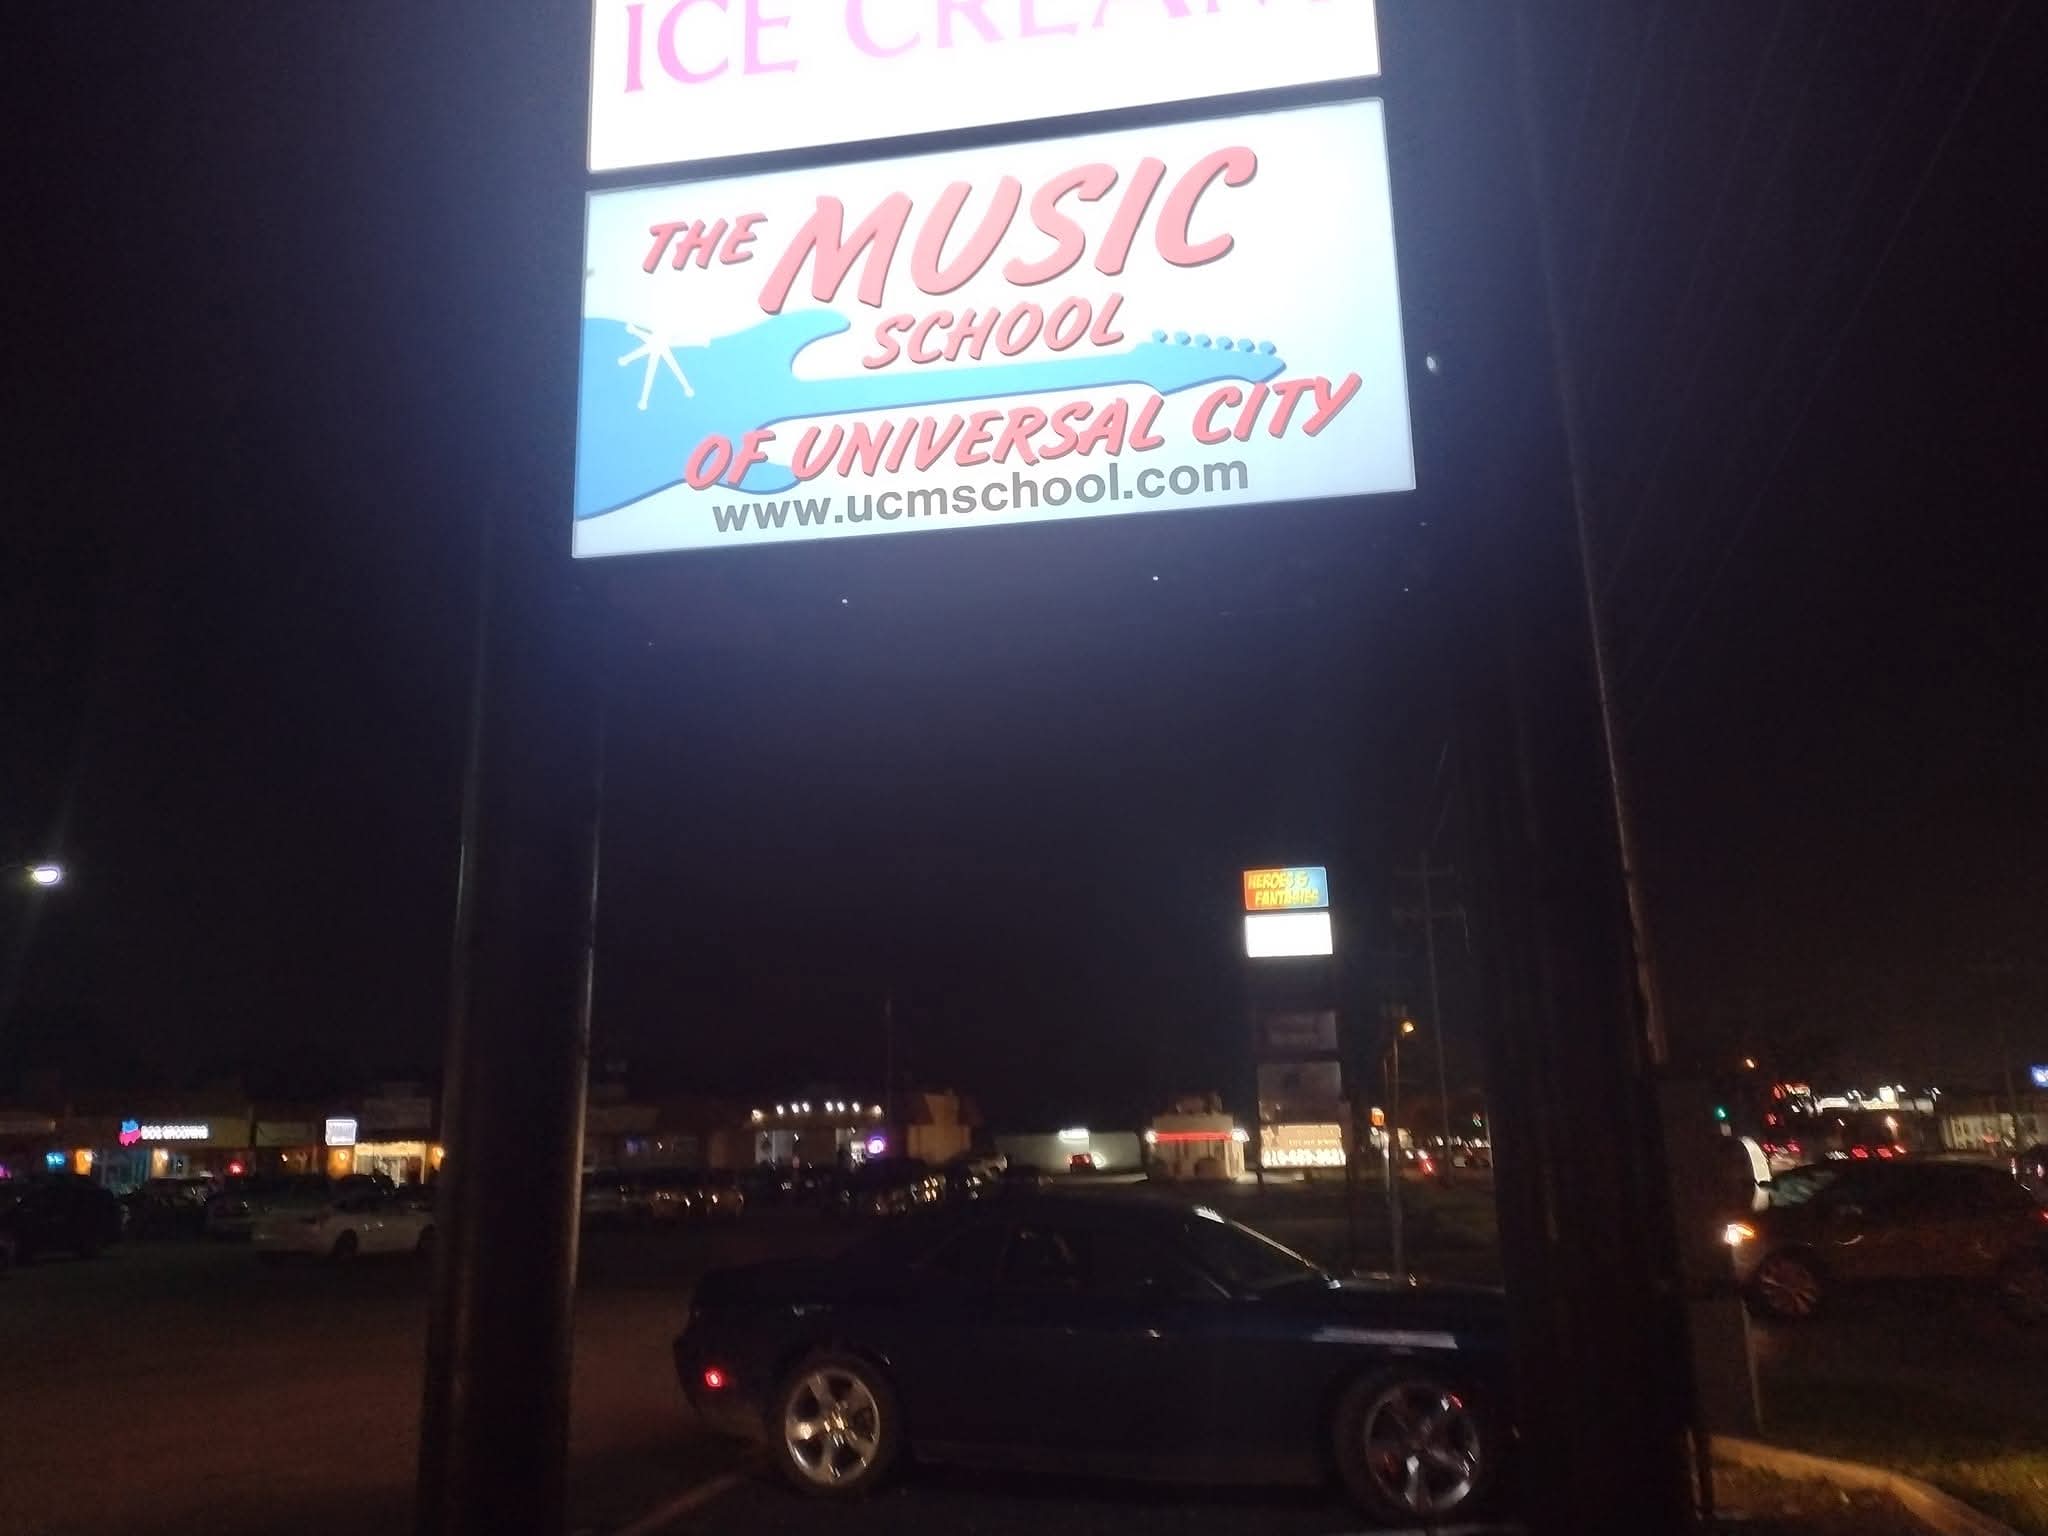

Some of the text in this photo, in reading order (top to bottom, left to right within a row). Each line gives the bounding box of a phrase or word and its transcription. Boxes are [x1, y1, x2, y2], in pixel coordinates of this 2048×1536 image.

[623, 0, 799, 93] ICE
[642, 146, 1257, 314] THE MUSIC
[862, 292, 1124, 369] SCHOOL
[684, 372, 1363, 491] OF UNIVERSAL CITY
[712, 461, 1250, 532] www.ucmschool.com
